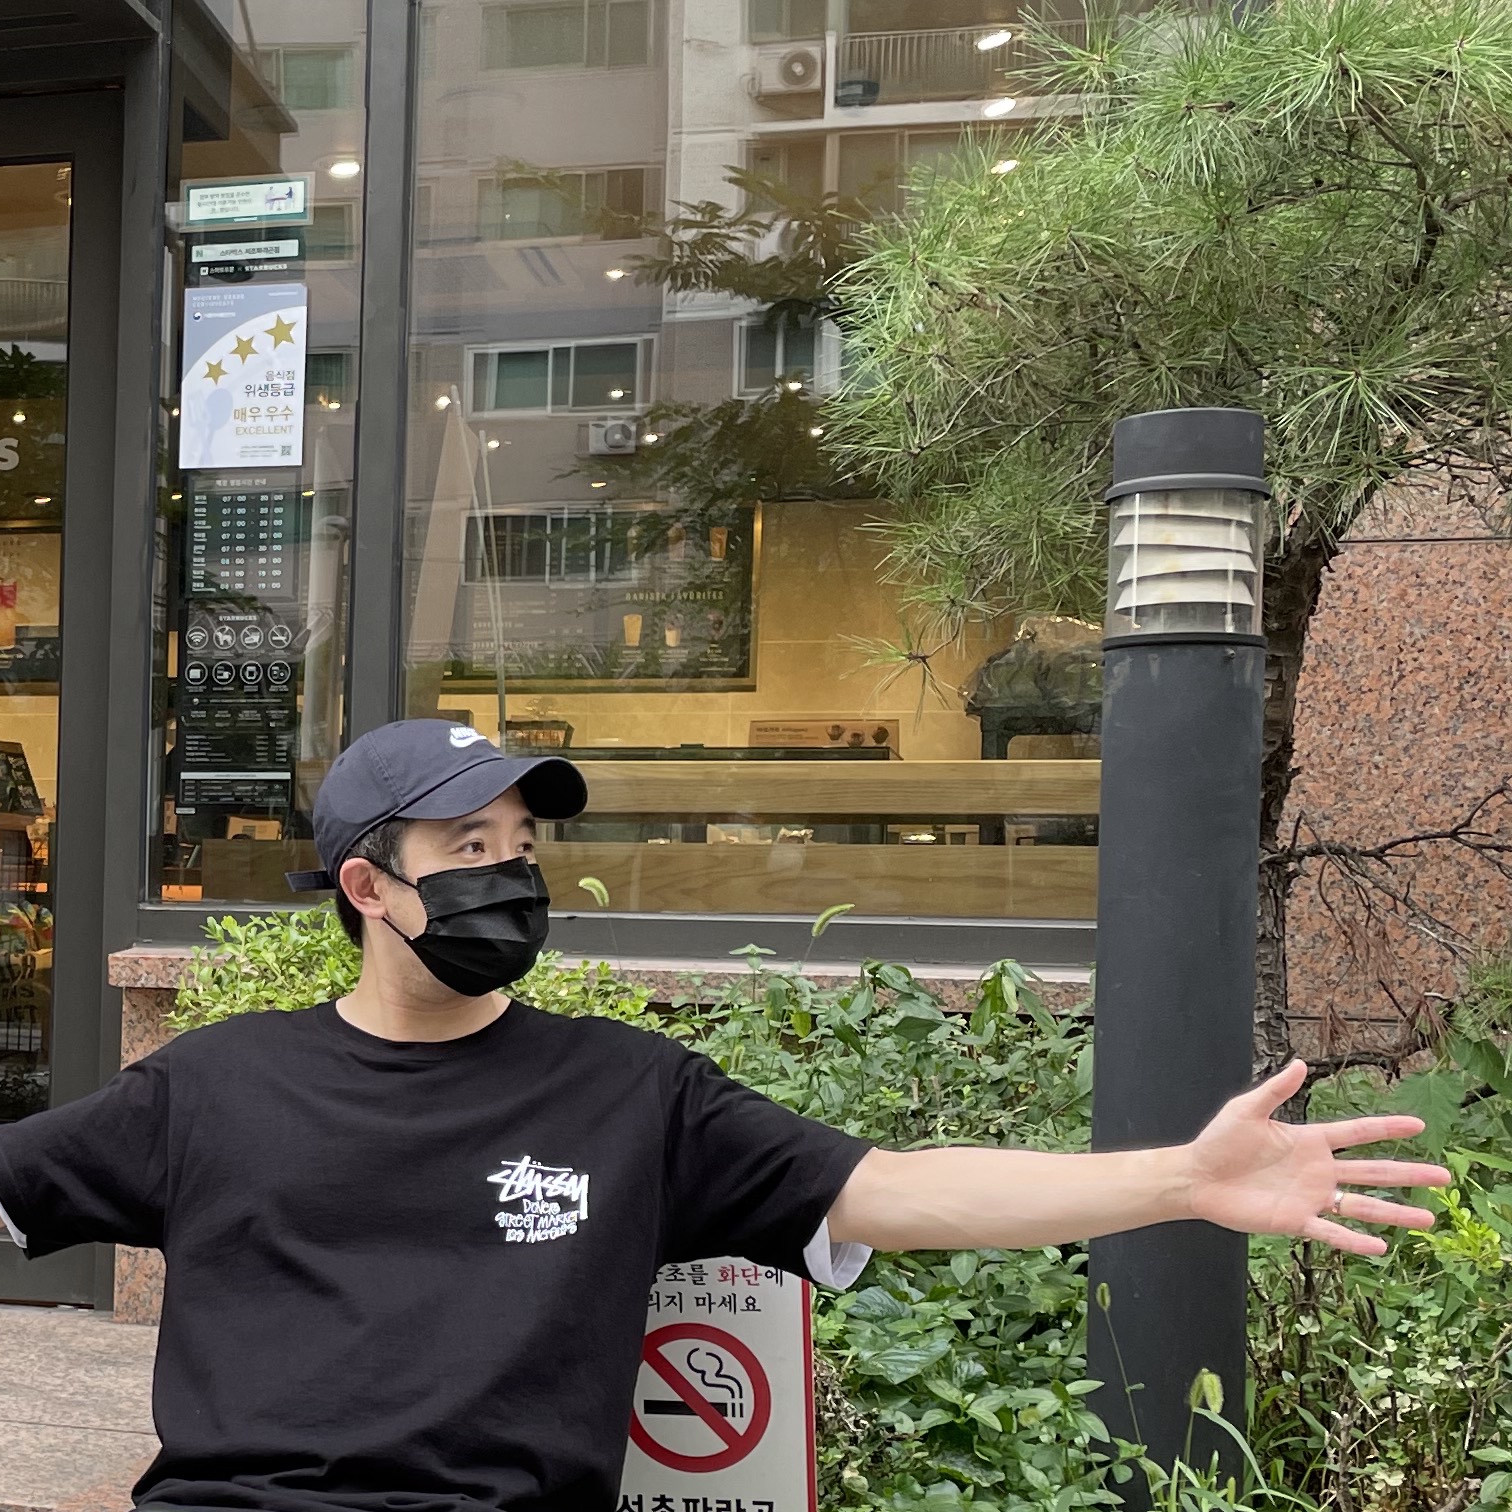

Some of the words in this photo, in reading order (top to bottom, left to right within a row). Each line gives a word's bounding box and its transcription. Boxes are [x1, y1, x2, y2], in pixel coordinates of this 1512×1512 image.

[266, 370, 295, 381] 음식점
[244, 383, 295, 398] 위생등급
[234, 407, 262, 422] 매우
[265, 405, 294, 421] 우수
[235, 425, 293, 435] EXCELLENT
[670, 590, 724, 600] FAVORITES
[658, 1264, 709, 1286] 초를
[717, 1264, 783, 1287] 화단에
[694, 1292, 762, 1314] 마세요
